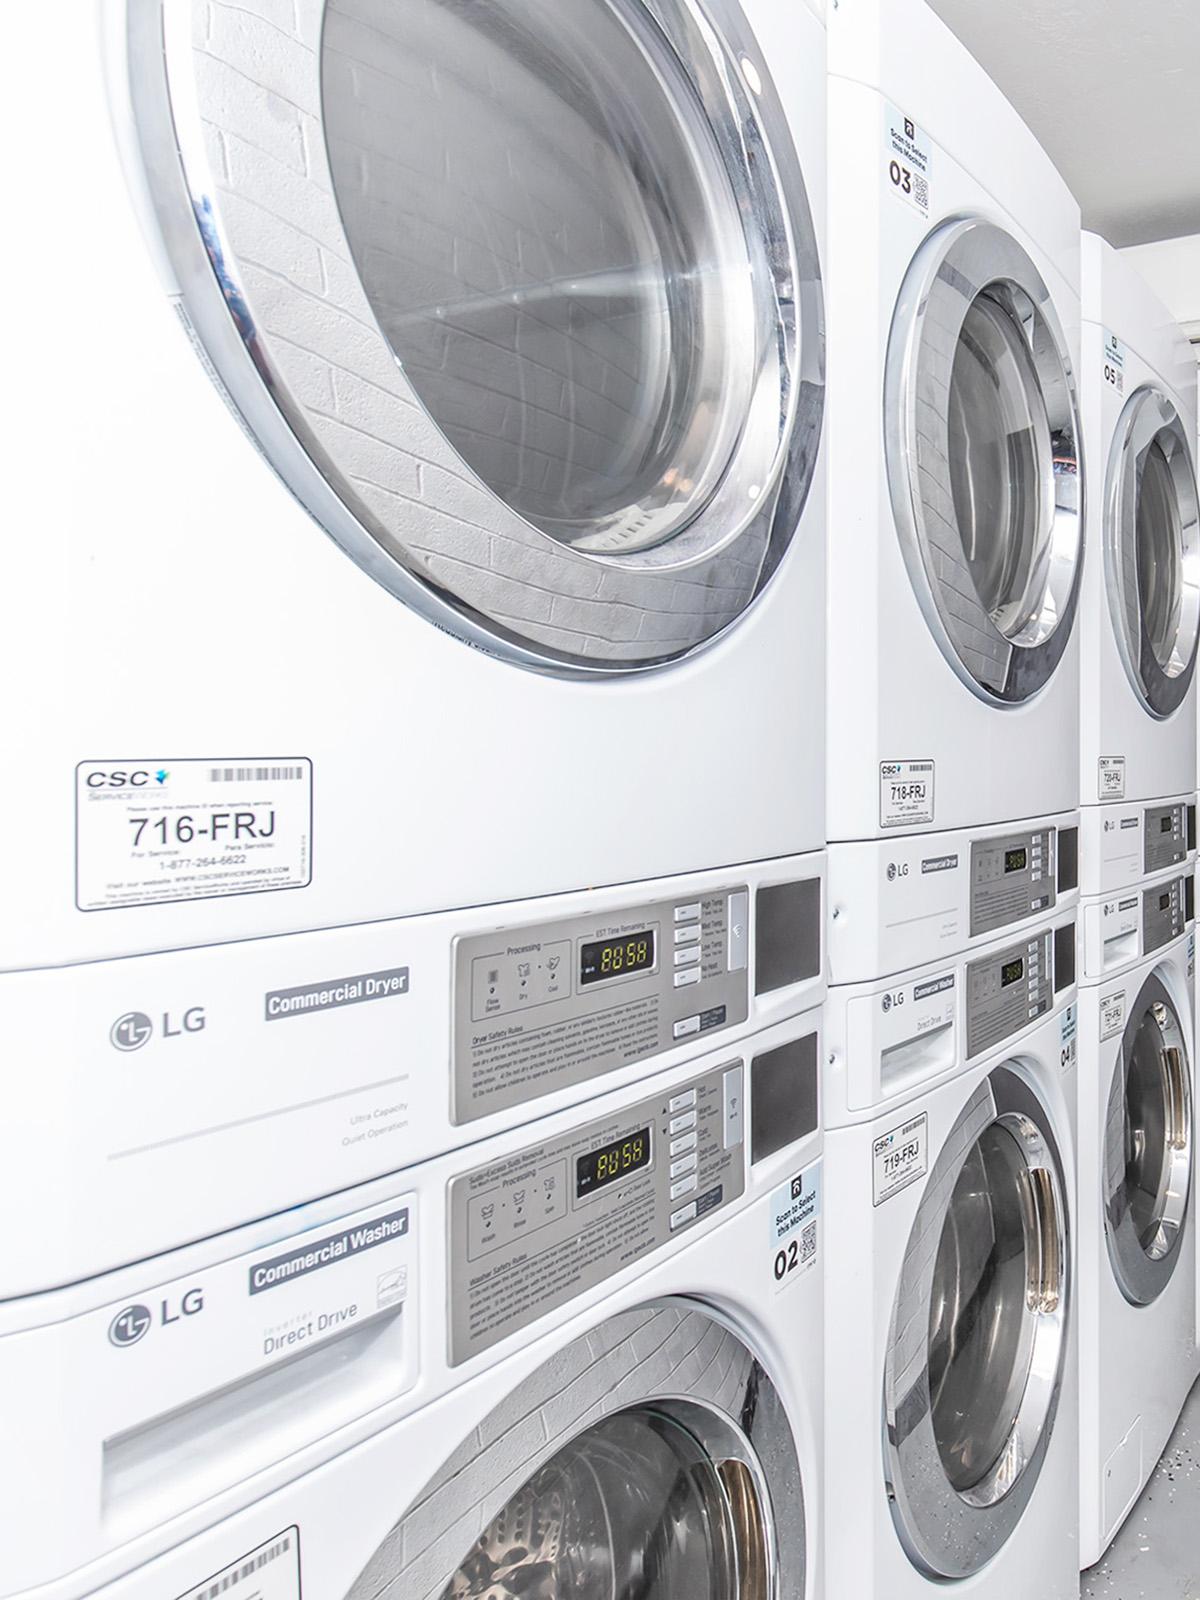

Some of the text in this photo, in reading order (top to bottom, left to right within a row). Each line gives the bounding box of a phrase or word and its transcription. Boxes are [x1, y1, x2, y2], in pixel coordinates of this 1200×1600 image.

[890, 160, 911, 194] 03
[1104, 364, 1116, 385] 05
[87, 771, 149, 787] CSC
[891, 785, 926, 800] 718-FRJ
[129, 811, 275, 847] 716-FRJ
[898, 863, 909, 877] LG
[507, 943, 540, 956] Processing
[268, 973, 406, 1015] Commercial Dryer
[893, 992, 904, 1007] LG
[163, 1007, 205, 1037] LG
[1061, 1045, 1069, 1067] 04
[350, 1101, 408, 1125] Ultra Capacity
[342, 1120, 408, 1146] Quiet Operation
[884, 1141, 919, 1173] 719-FRJ
[502, 1169, 536, 1188] Processing
[776, 1190, 816, 1226] Scan to Select
[777, 1205, 815, 1237] this Machine
[254, 1216, 406, 1287] Commercial Washer
[774, 1240, 798, 1281] 02
[161, 1288, 204, 1326] LG
[264, 1303, 358, 1355] Direct Drive
